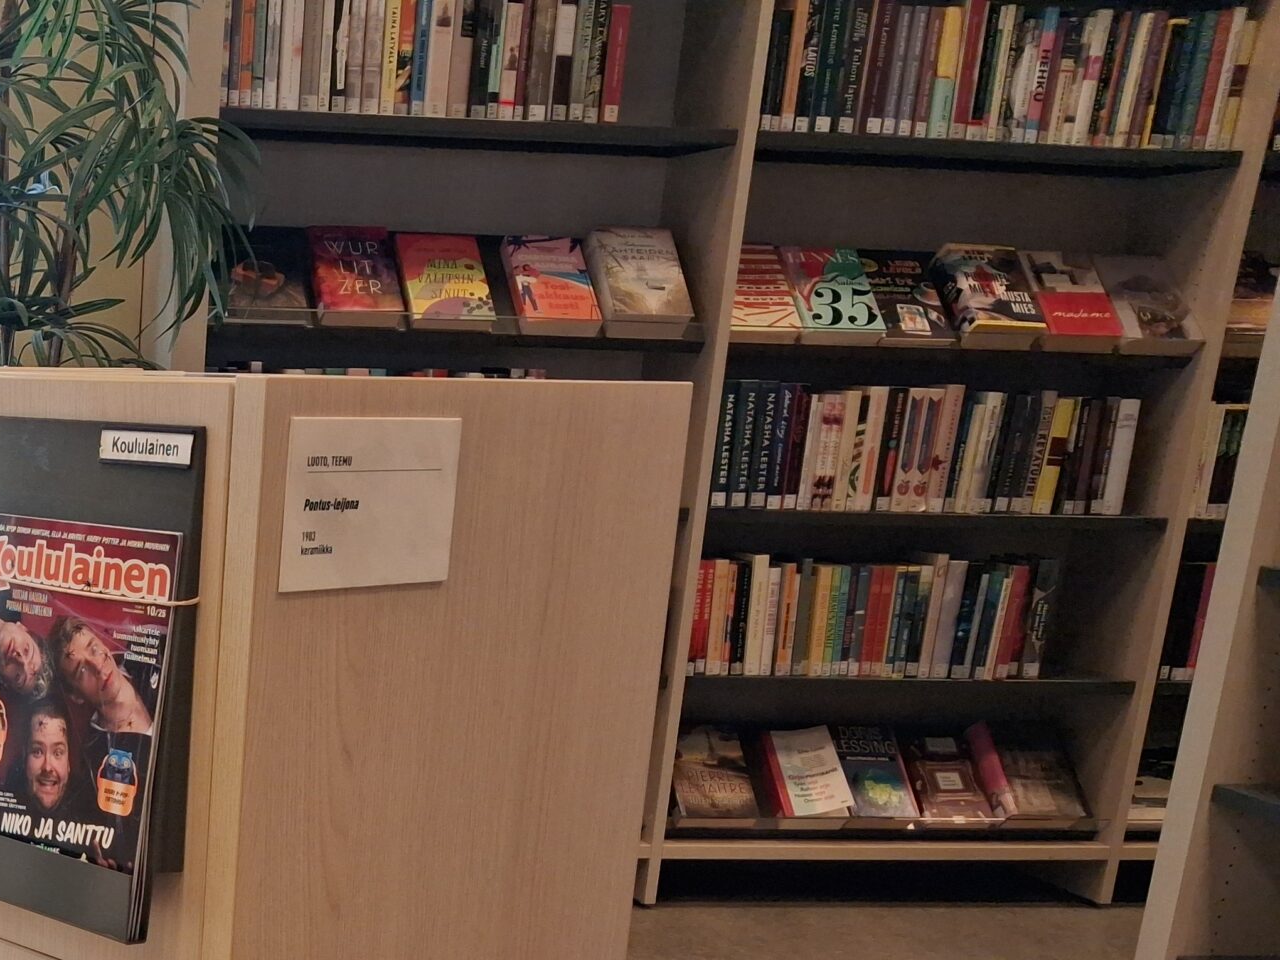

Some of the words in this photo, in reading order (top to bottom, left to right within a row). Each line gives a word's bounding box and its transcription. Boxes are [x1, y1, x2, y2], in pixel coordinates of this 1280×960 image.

[804, 47, 819, 78] LAITOS
[848, 48, 862, 81] Tuhon
[1033, 49, 1052, 102] HEHKU
[844, 85, 858, 114] lapset
[323, 240, 379, 255] WUR
[339, 259, 373, 275] LIT
[338, 279, 383, 294] ZER
[418, 272, 474, 284] VALITSIN
[431, 288, 468, 299] SINUT
[999, 290, 1032, 303] MUSTA
[812, 287, 878, 327] 35
[1010, 302, 1037, 315] MIES
[1052, 308, 1113, 318] madame
[723, 394, 736, 443] NATASHA
[744, 392, 756, 447] NATASHA
[762, 393, 776, 447] NATASHA
[111, 436, 180, 458] Koululainen
[307, 455, 330, 468] LUOTO,
[331, 455, 352, 467] TEEMU
[718, 446, 730, 484] LESTER
[738, 450, 750, 490] LESTER
[756, 450, 769, 490] LESTER
[303, 498, 359, 514] Pontus-leijona
[300, 545, 333, 556] keramiikka
[837, 726, 884, 740] DORIS
[833, 739, 897, 754] LESSING
[0, 812, 32, 837] NIKO
[34, 817, 54, 840] JA
[55, 820, 115, 849] SANTTU
